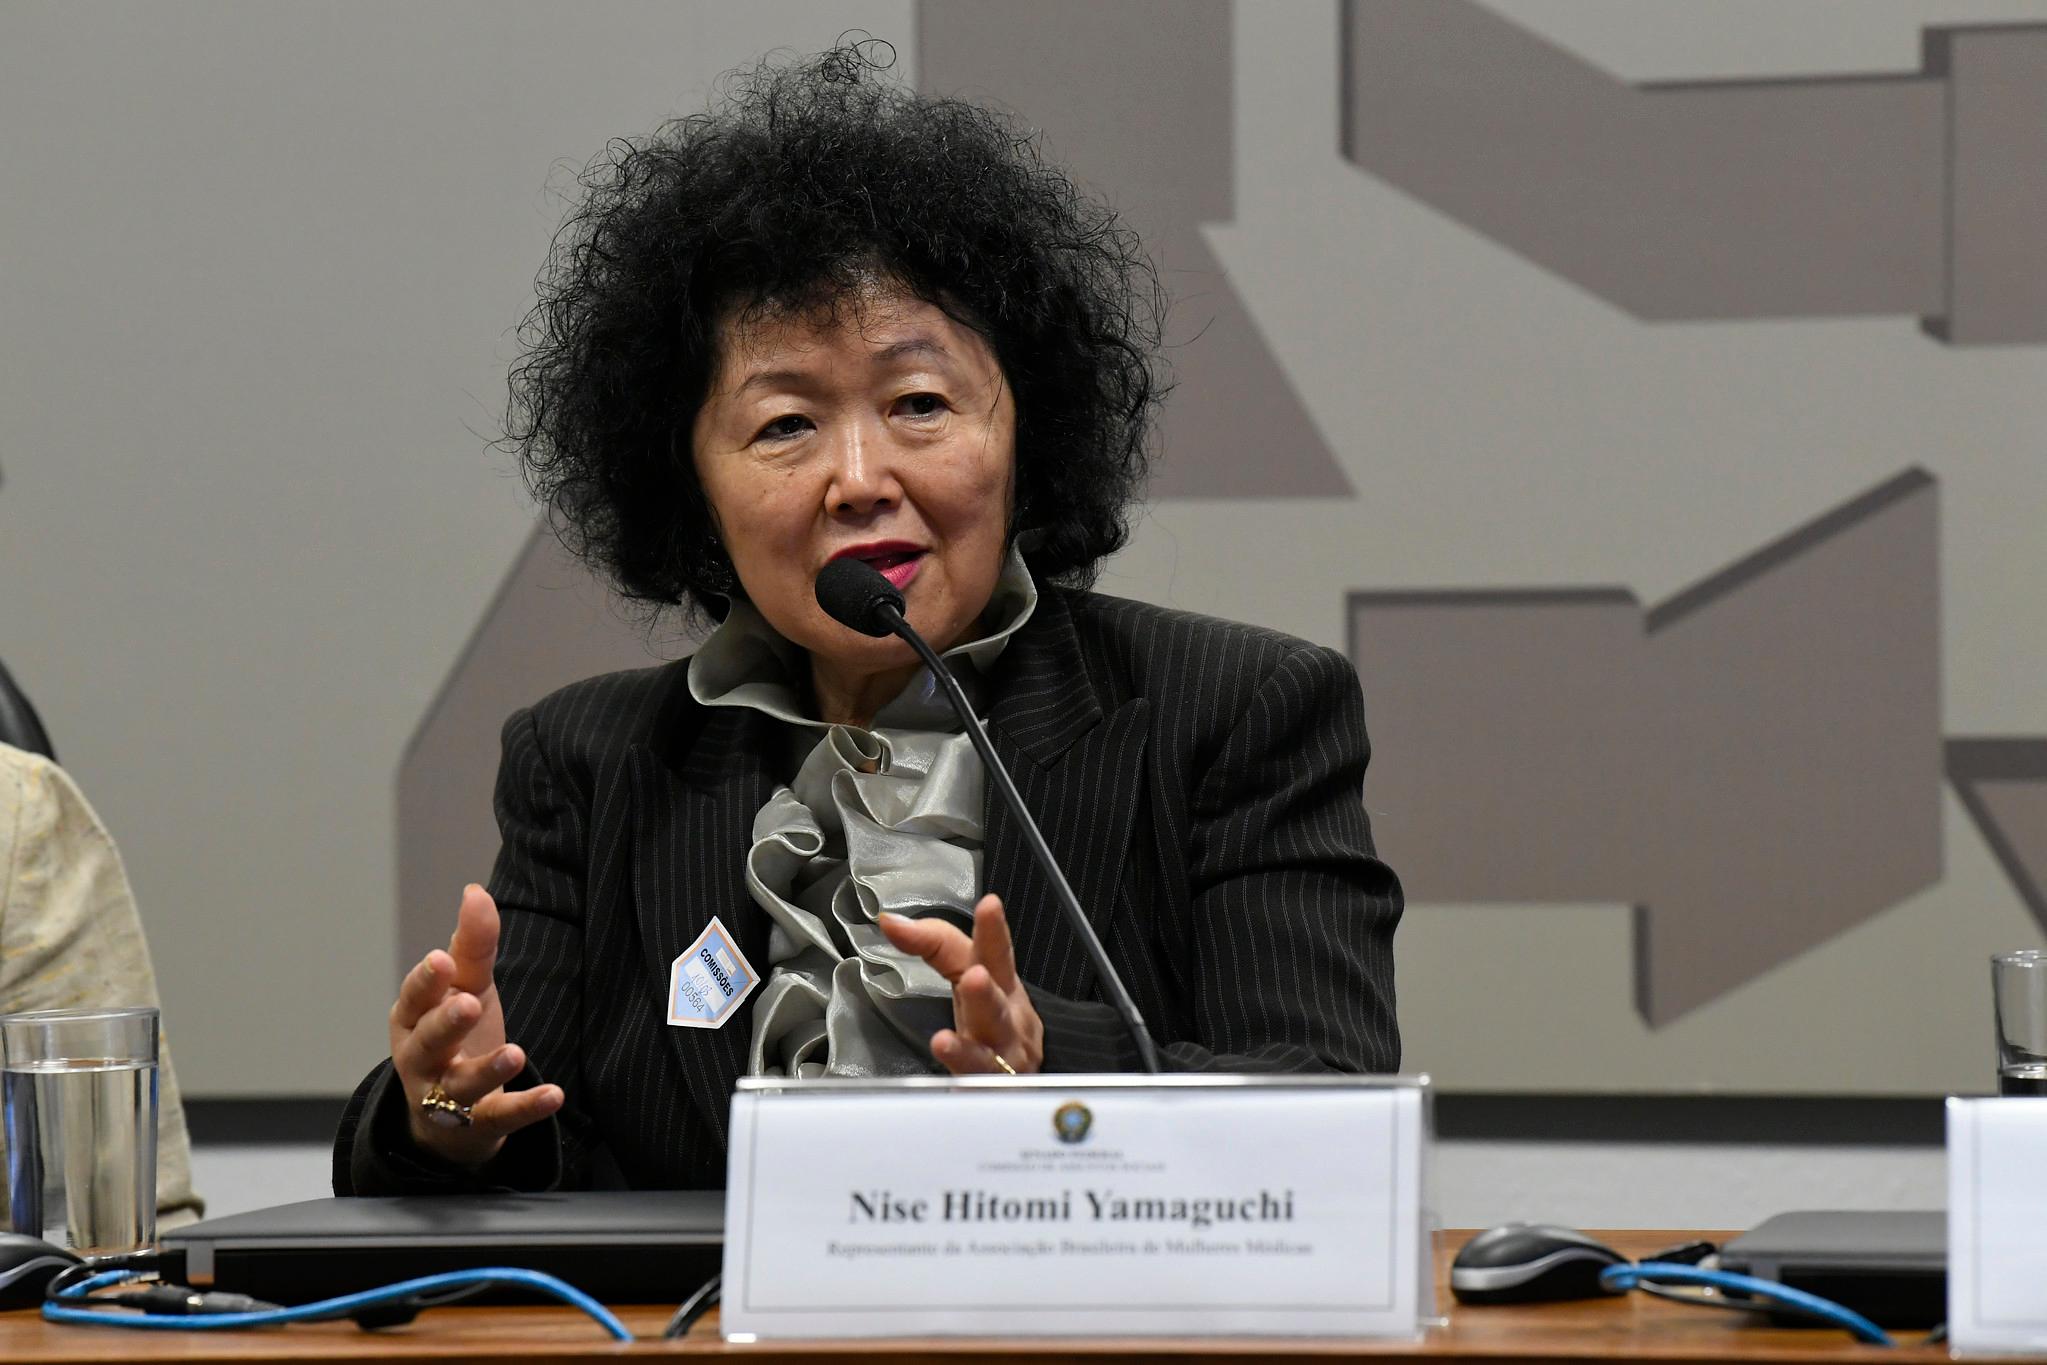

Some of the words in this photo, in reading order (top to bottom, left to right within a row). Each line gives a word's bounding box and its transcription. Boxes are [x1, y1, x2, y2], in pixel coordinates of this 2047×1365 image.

[700, 948, 734, 997] COMISSÕES
[681, 981, 705, 1013] 00564
[849, 1190, 928, 1223] Nise
[942, 1190, 1072, 1222] Hitomi
[1086, 1190, 1295, 1227] Yamaguchi
